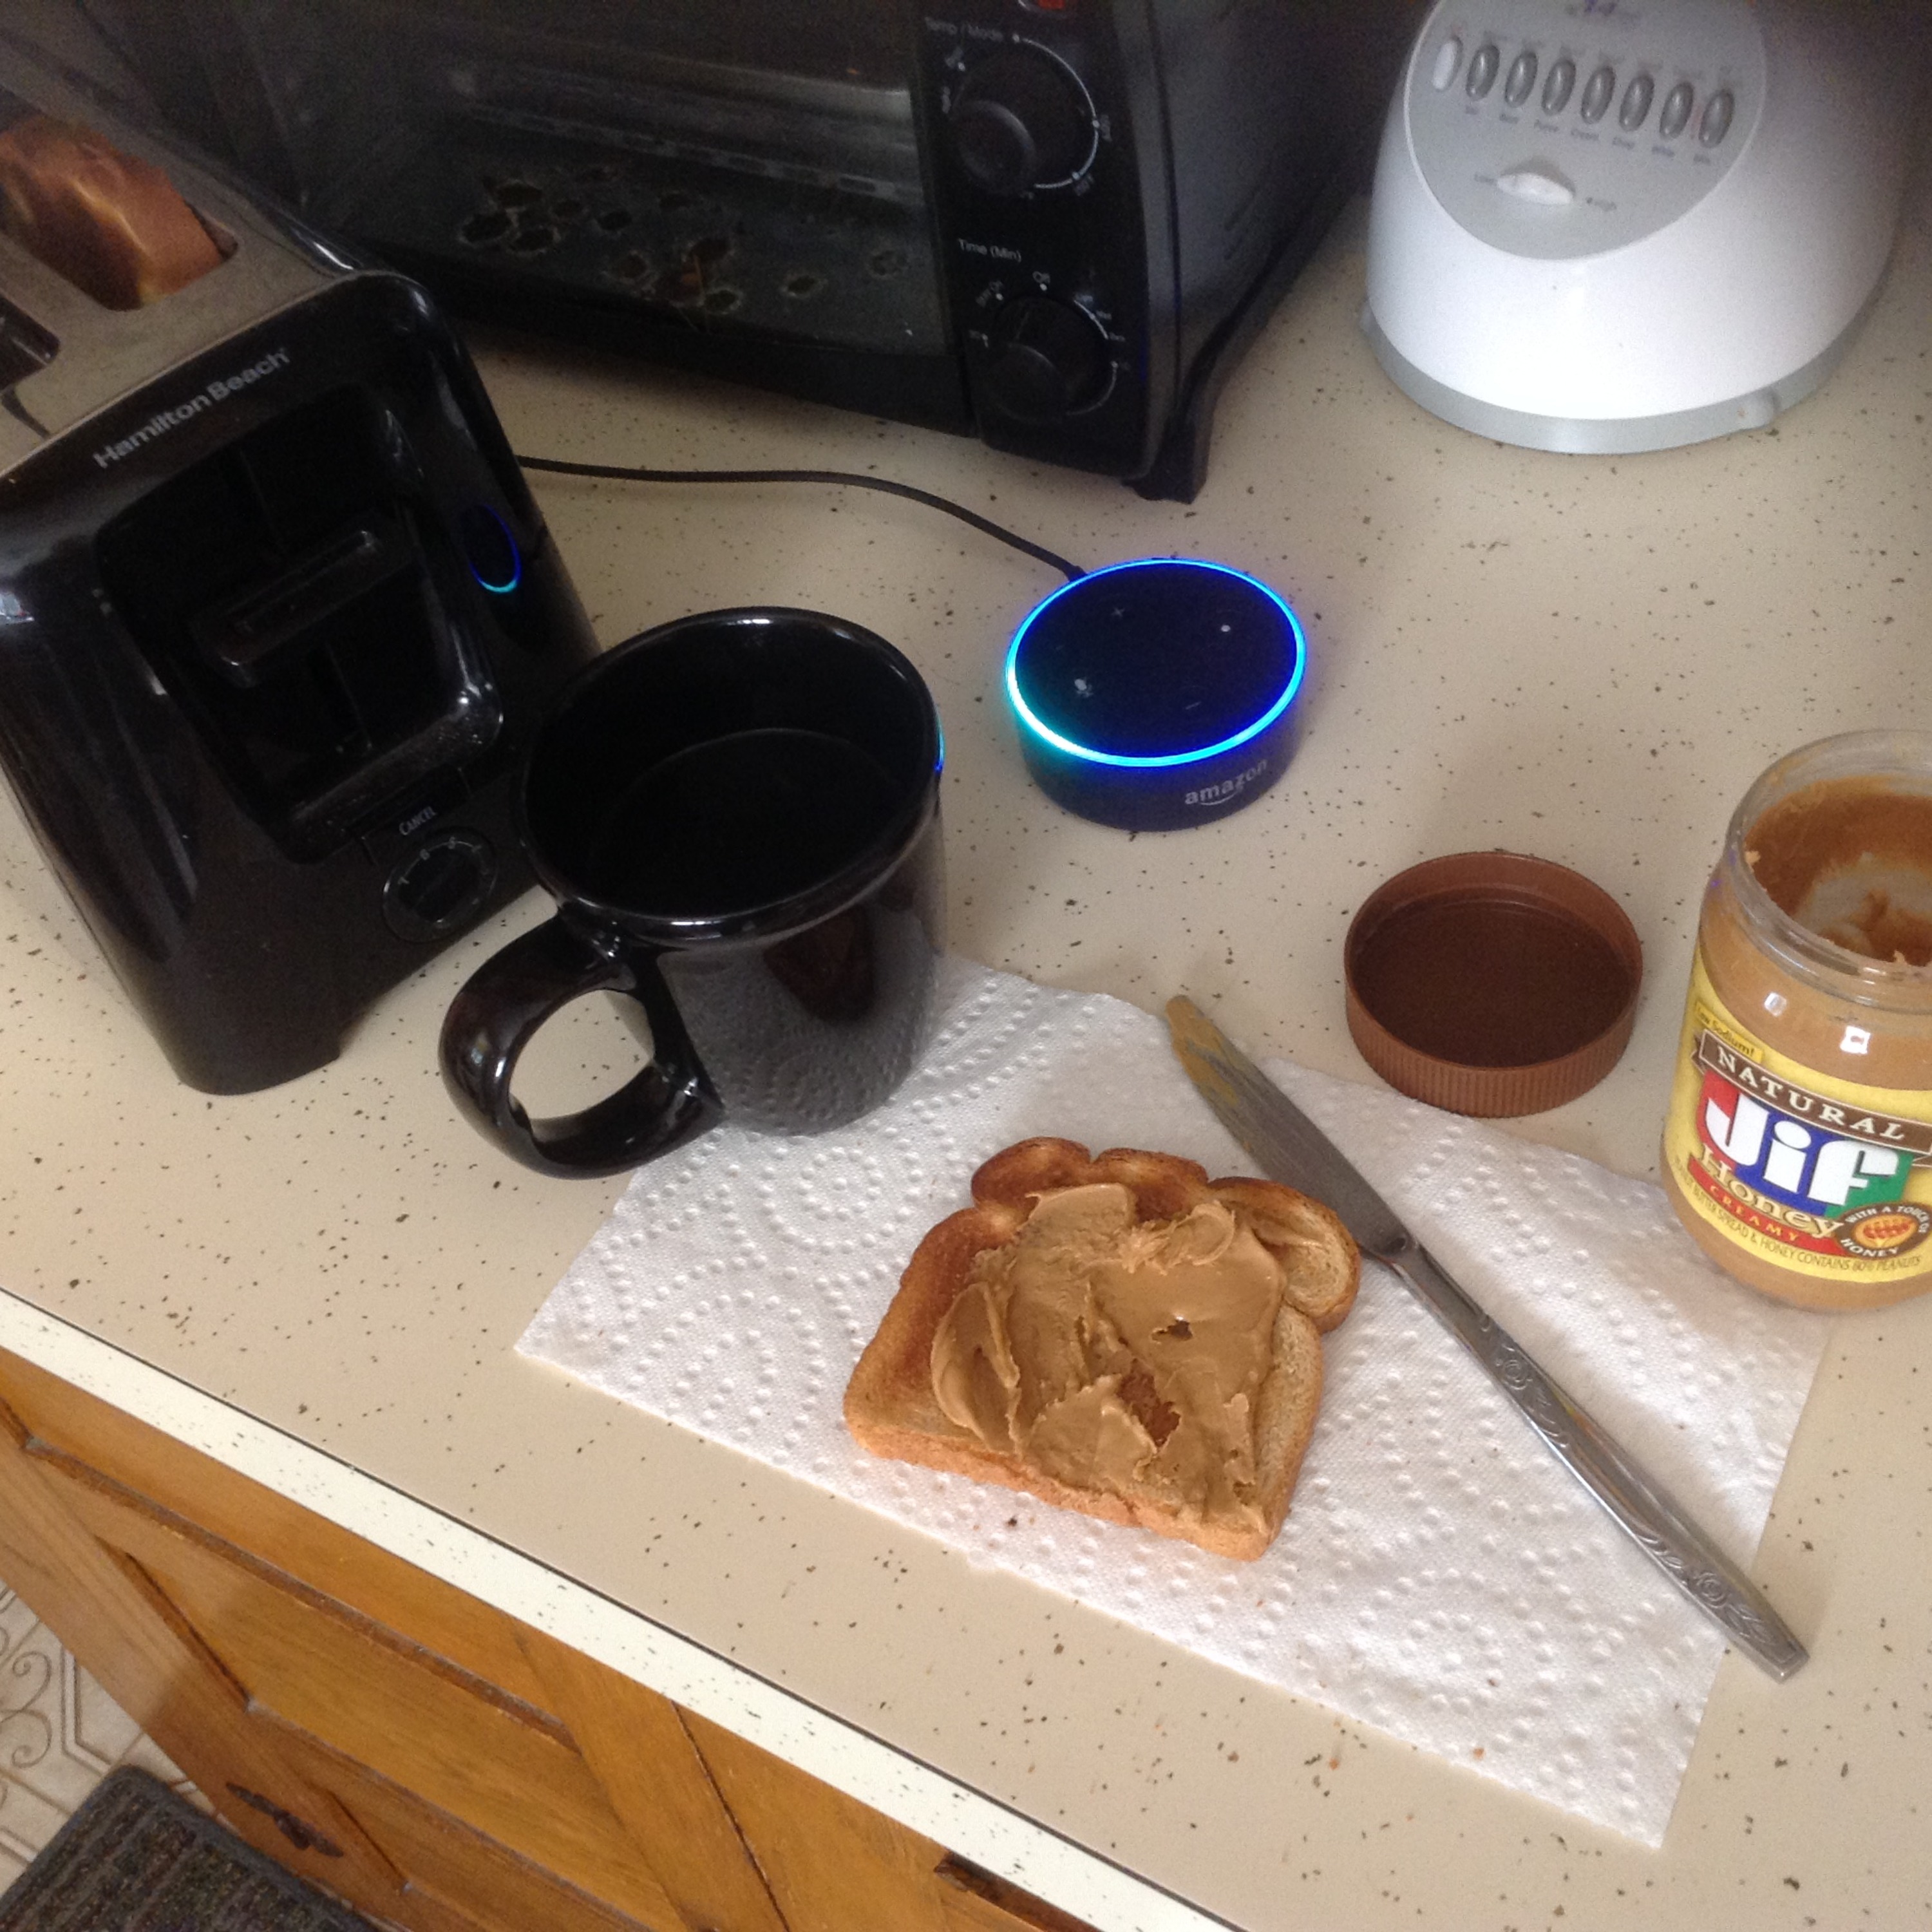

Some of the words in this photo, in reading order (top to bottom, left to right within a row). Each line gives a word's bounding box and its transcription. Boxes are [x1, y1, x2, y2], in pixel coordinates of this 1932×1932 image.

[93, 393, 213, 469] Hamilton
[207, 351, 290, 401] Beach
[1184, 759, 1268, 805] amazon
[1712, 1020, 1755, 1057] Sodium!
[1717, 1044, 1906, 1140] NATURAL
[1705, 1092, 1899, 1206] Jif
[1701, 1143, 1845, 1239] Honey
[1710, 1186, 1799, 1242] CREAMY
[1845, 1208, 1878, 1224] WITH
[1897, 1206, 1930, 1223] TOUCH
[1718, 1211, 1749, 1238] SPREAD
[1750, 1233, 1757, 1244] &
[1760, 1236, 1796, 1258] HONEY
[1796, 1251, 1851, 1271] CONTAINS
[1840, 1238, 1900, 1257] HONEY
